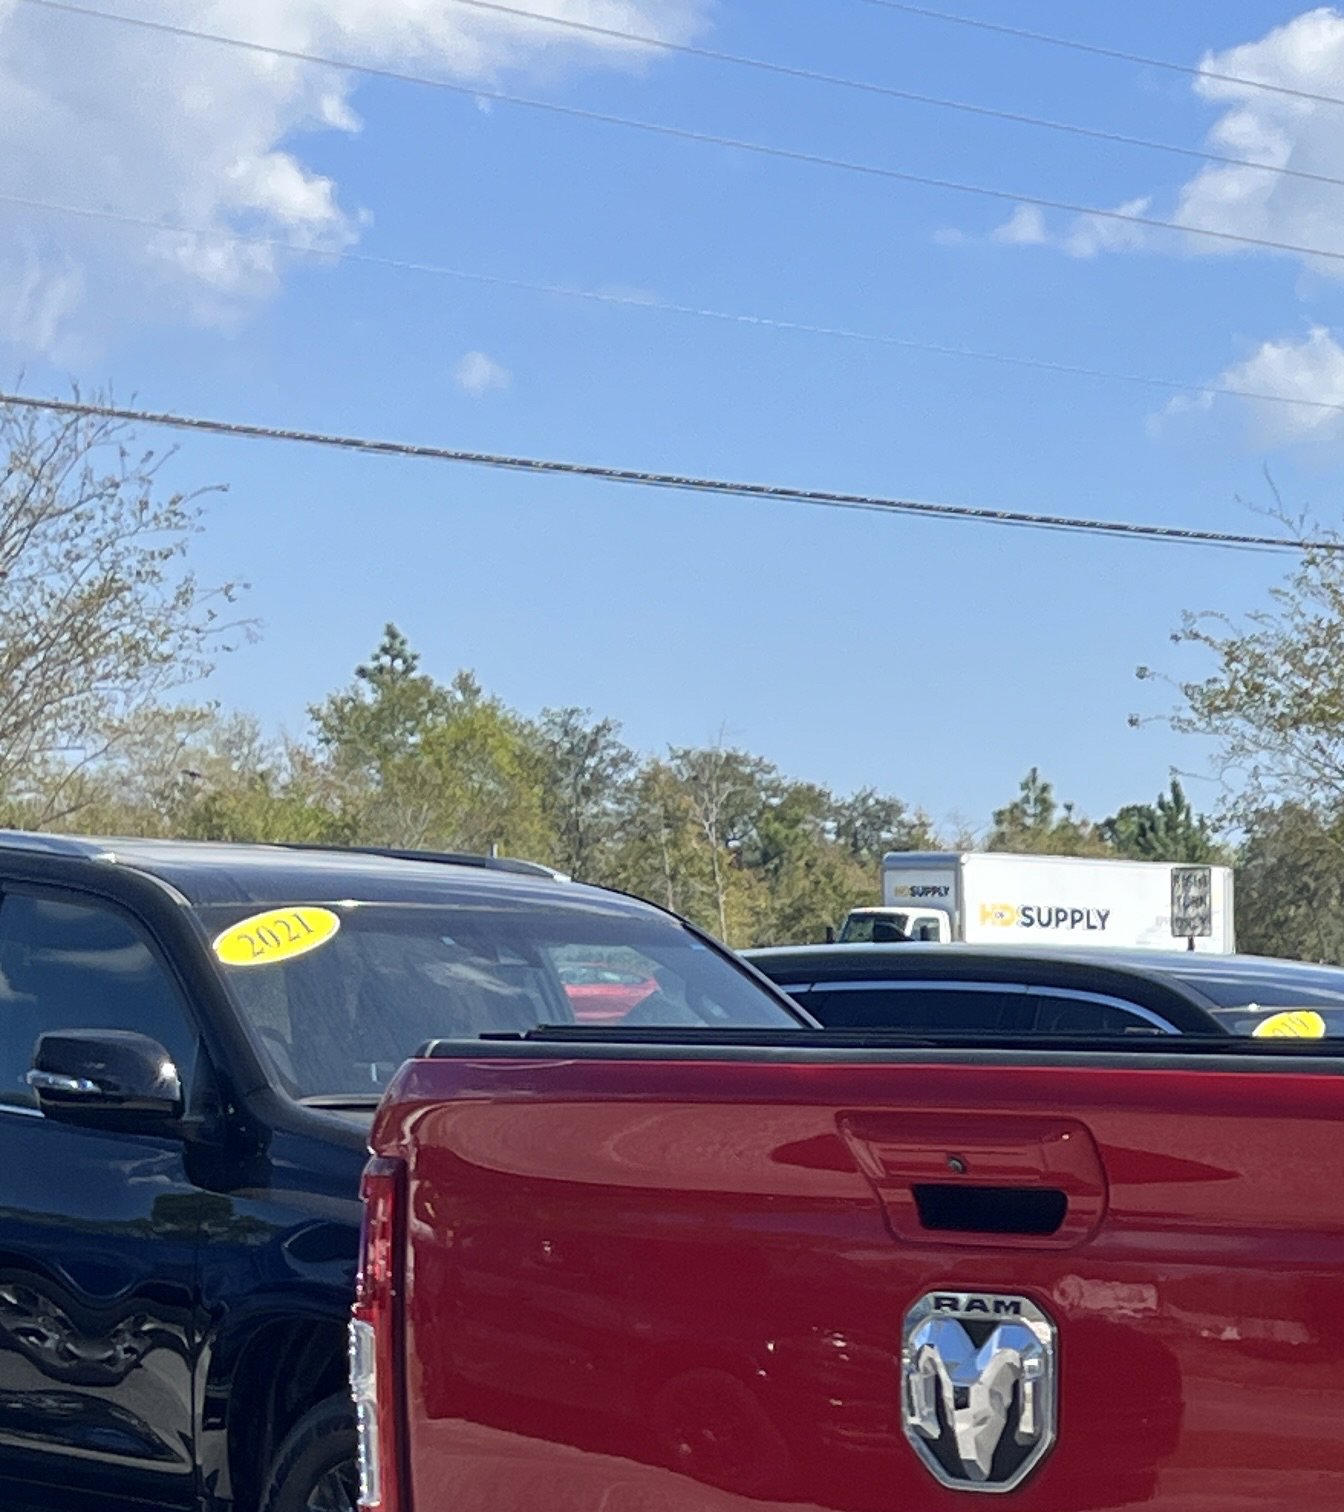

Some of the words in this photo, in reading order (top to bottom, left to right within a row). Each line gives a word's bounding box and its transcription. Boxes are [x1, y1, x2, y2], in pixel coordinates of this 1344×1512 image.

[909, 885, 950, 898] SUPPLY
[1020, 905, 1111, 931] SUPPLY
[237, 913, 315, 958] 2021
[932, 1296, 1023, 1316] RAM
